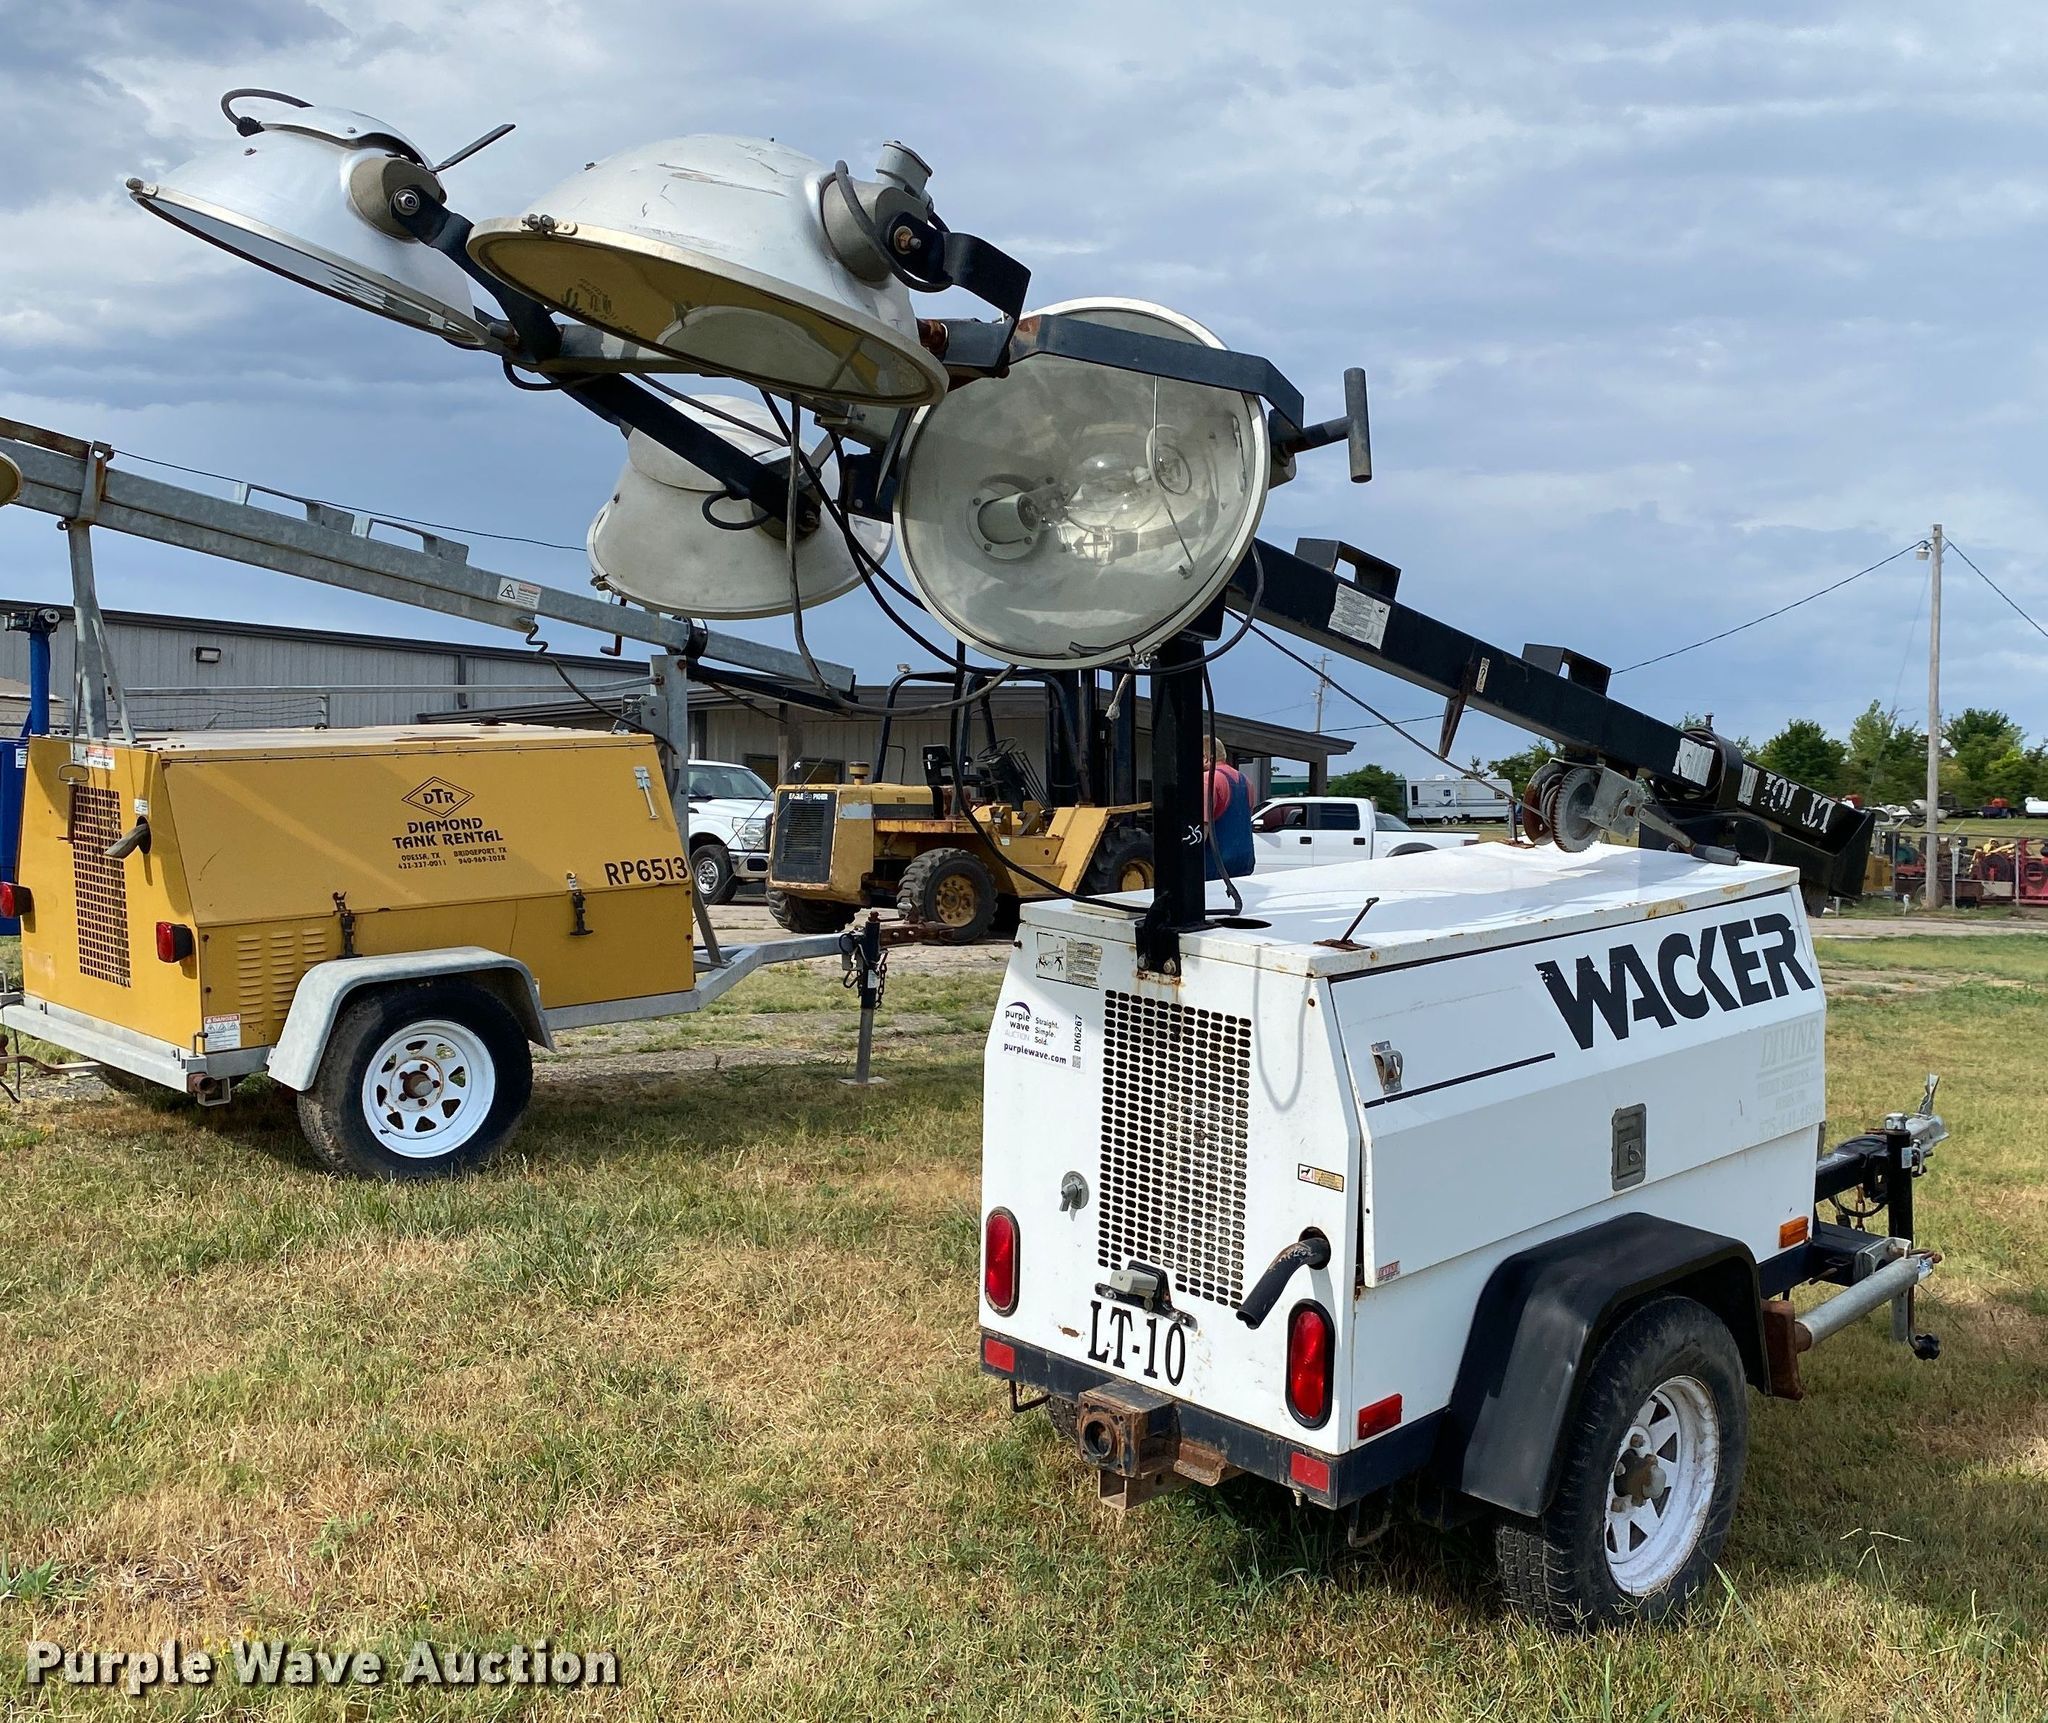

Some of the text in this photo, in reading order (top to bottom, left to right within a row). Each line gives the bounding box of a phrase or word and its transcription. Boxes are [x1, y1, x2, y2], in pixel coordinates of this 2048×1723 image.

[423, 788, 456, 805] DTR
[407, 818, 483, 834] DIAMOND
[392, 830, 504, 850] TANK RENTAL
[604, 856, 688, 886] RP6513
[1534, 912, 1816, 1050] WACKER
[1005, 1010, 1030, 1022] purple
[1035, 1017, 1059, 1029] Straight.
[1009, 1021, 1030, 1032] wave
[1034, 1026, 1056, 1039] Simple.
[1073, 1014, 1083, 1052] DK6267
[1004, 1029, 1030, 1041] AUCTION
[1034, 1036, 1049, 1046] Sold.
[1003, 1042, 1067, 1064] purplewave.com
[1087, 1300, 1186, 1387] LT-10
